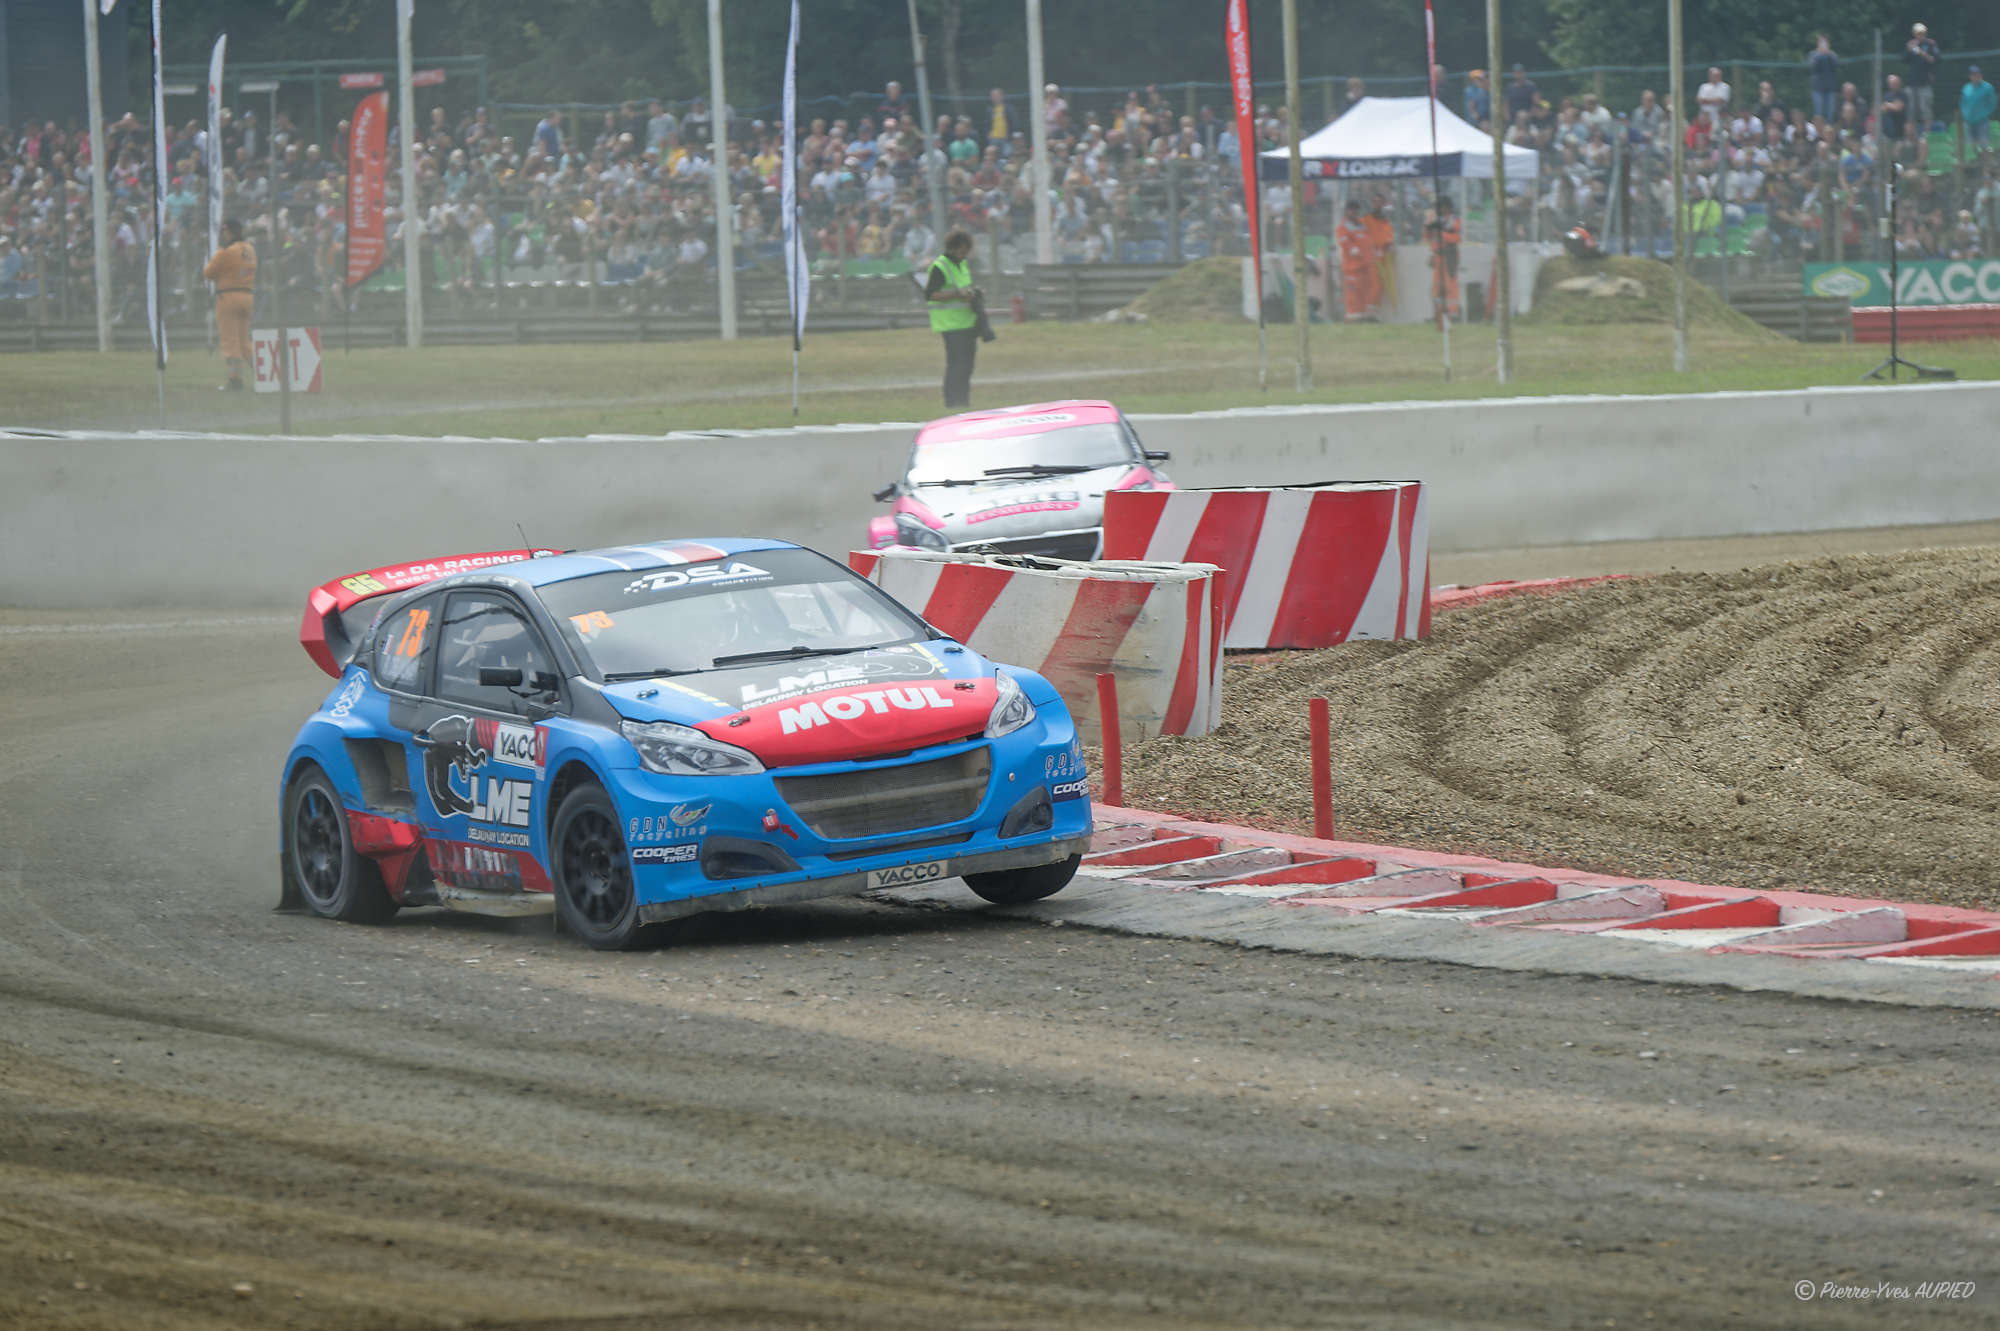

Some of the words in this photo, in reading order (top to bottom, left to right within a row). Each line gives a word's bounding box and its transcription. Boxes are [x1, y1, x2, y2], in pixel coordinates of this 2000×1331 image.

[255, 339, 301, 382] EXT
[409, 563, 438, 575] DA
[444, 554, 525, 569] RACING
[642, 562, 771, 590] DSA
[396, 609, 430, 657] 73
[569, 610, 615, 633] 73
[740, 666, 866, 702] LME
[742, 689, 805, 711] DELAUNAY
[807, 679, 869, 694] LOCATION
[778, 687, 955, 735] MOTUL
[470, 774, 533, 829] LME
[630, 816, 667, 833] GDN
[630, 825, 708, 842] recycling
[632, 844, 698, 859] COOPER
[663, 855, 697, 863] TIRES
[876, 863, 940, 885] YACCO
